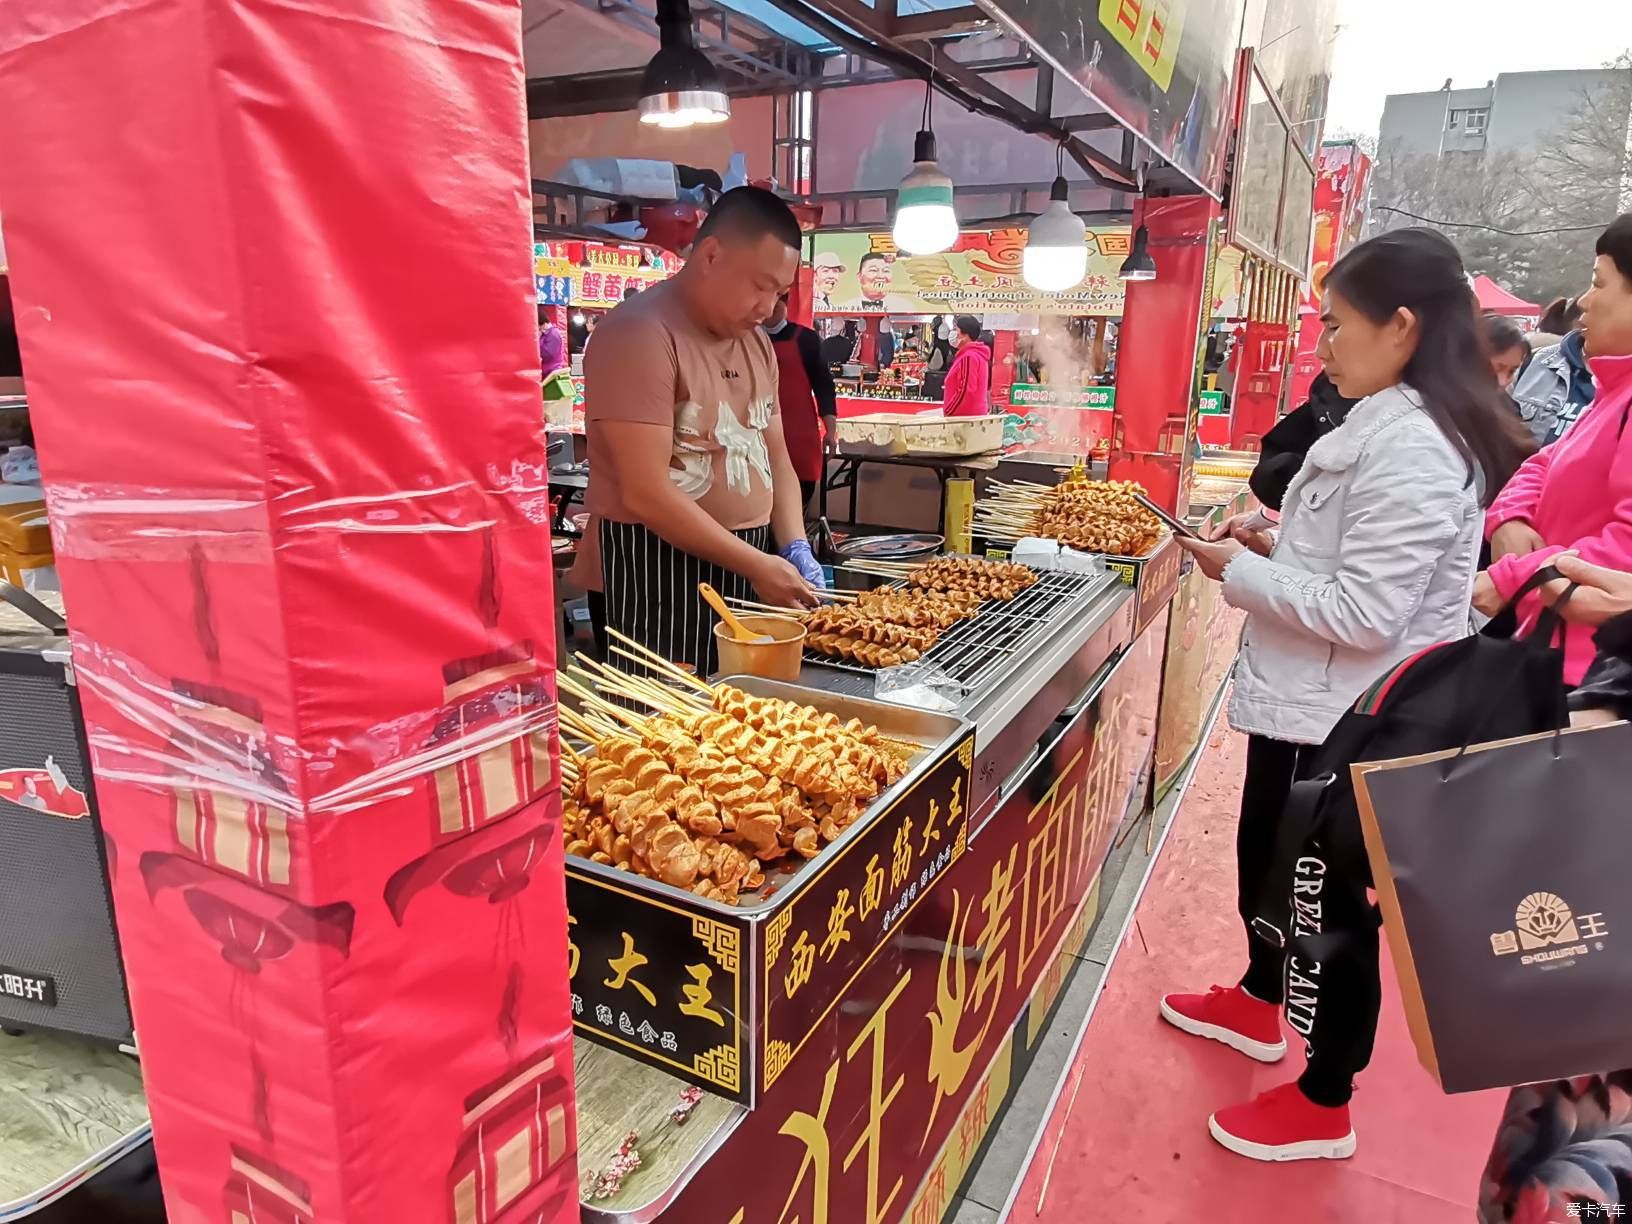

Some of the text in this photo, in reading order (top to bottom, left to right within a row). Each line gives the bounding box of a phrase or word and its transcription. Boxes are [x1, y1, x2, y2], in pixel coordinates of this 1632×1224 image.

[784, 776, 962, 1000] 西安面筋大王
[595, 1003, 678, 1052] 绿色食品
